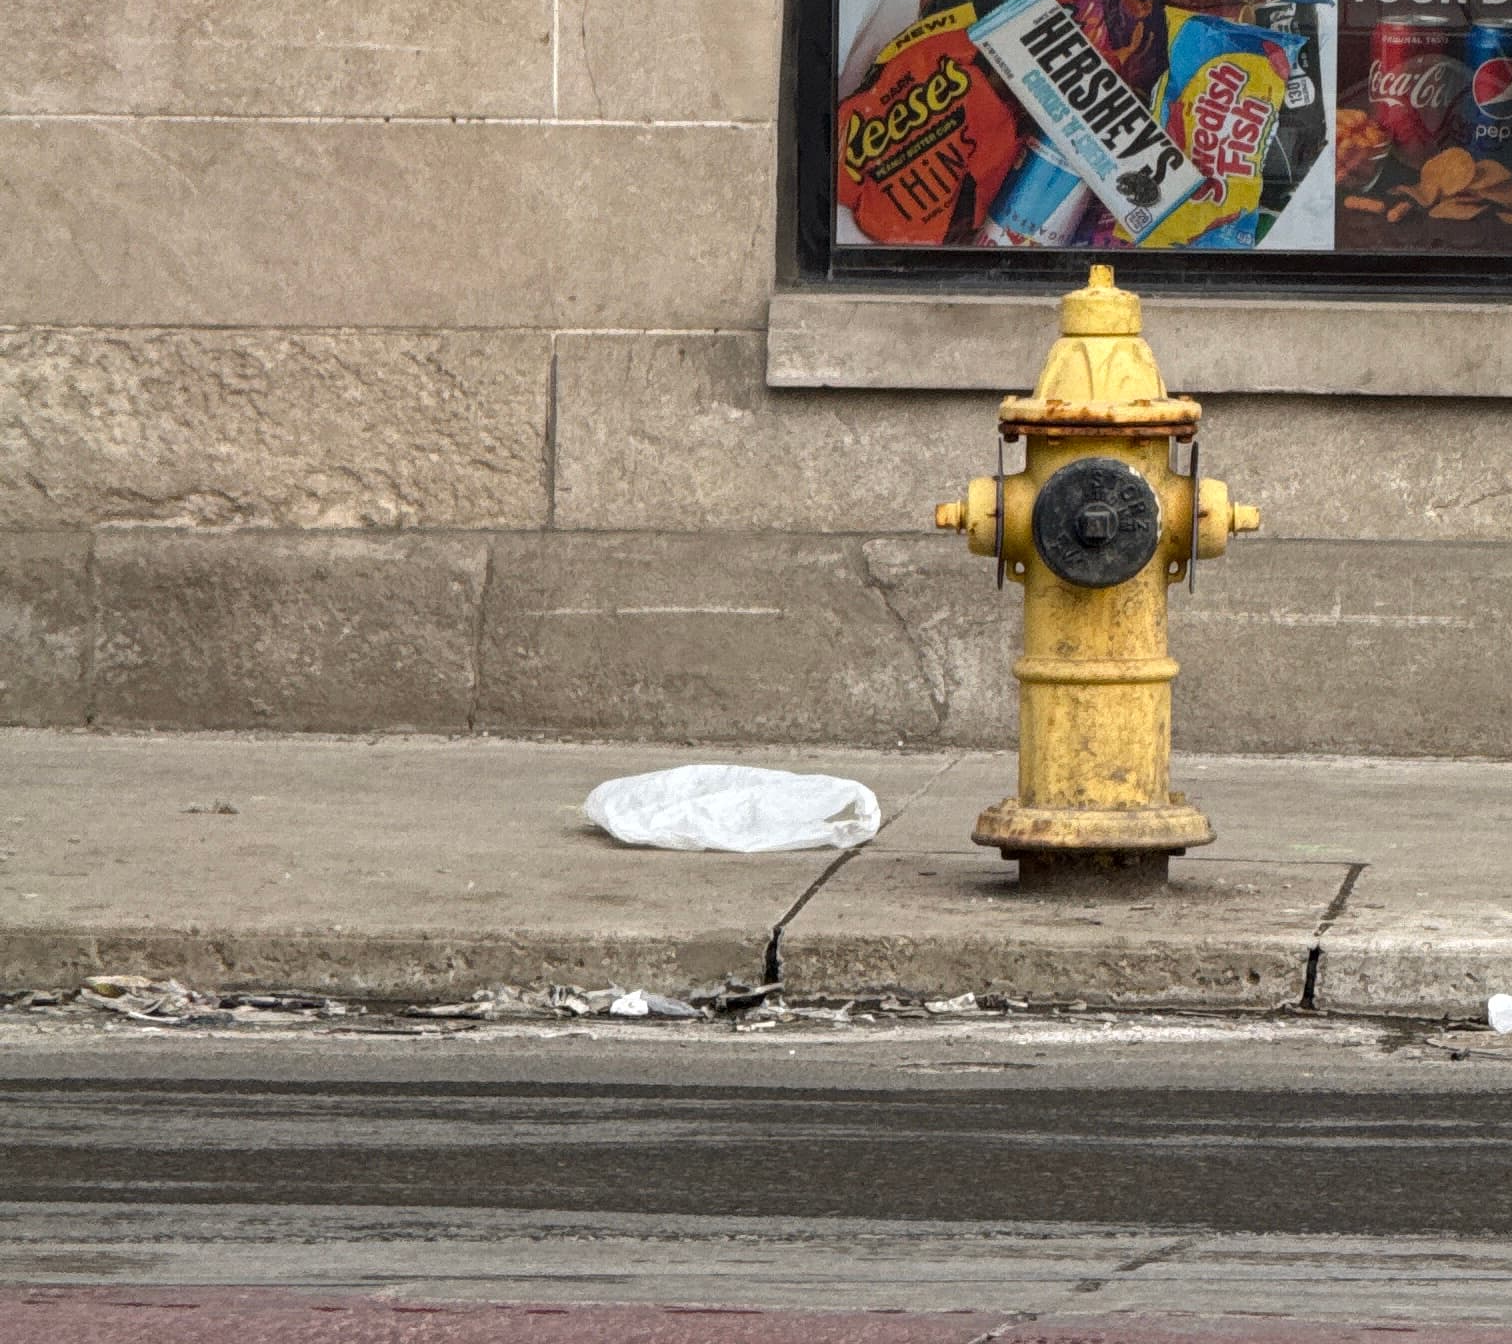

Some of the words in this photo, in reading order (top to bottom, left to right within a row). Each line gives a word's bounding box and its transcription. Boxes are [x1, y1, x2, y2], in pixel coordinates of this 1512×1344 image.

[895, 14, 956, 48] NEW!
[880, 71, 914, 104] DARK
[1019, 11, 1185, 184] HERSHEY'S
[1289, 78, 1303, 105] 130
[1216, 100, 1270, 177] Fish
